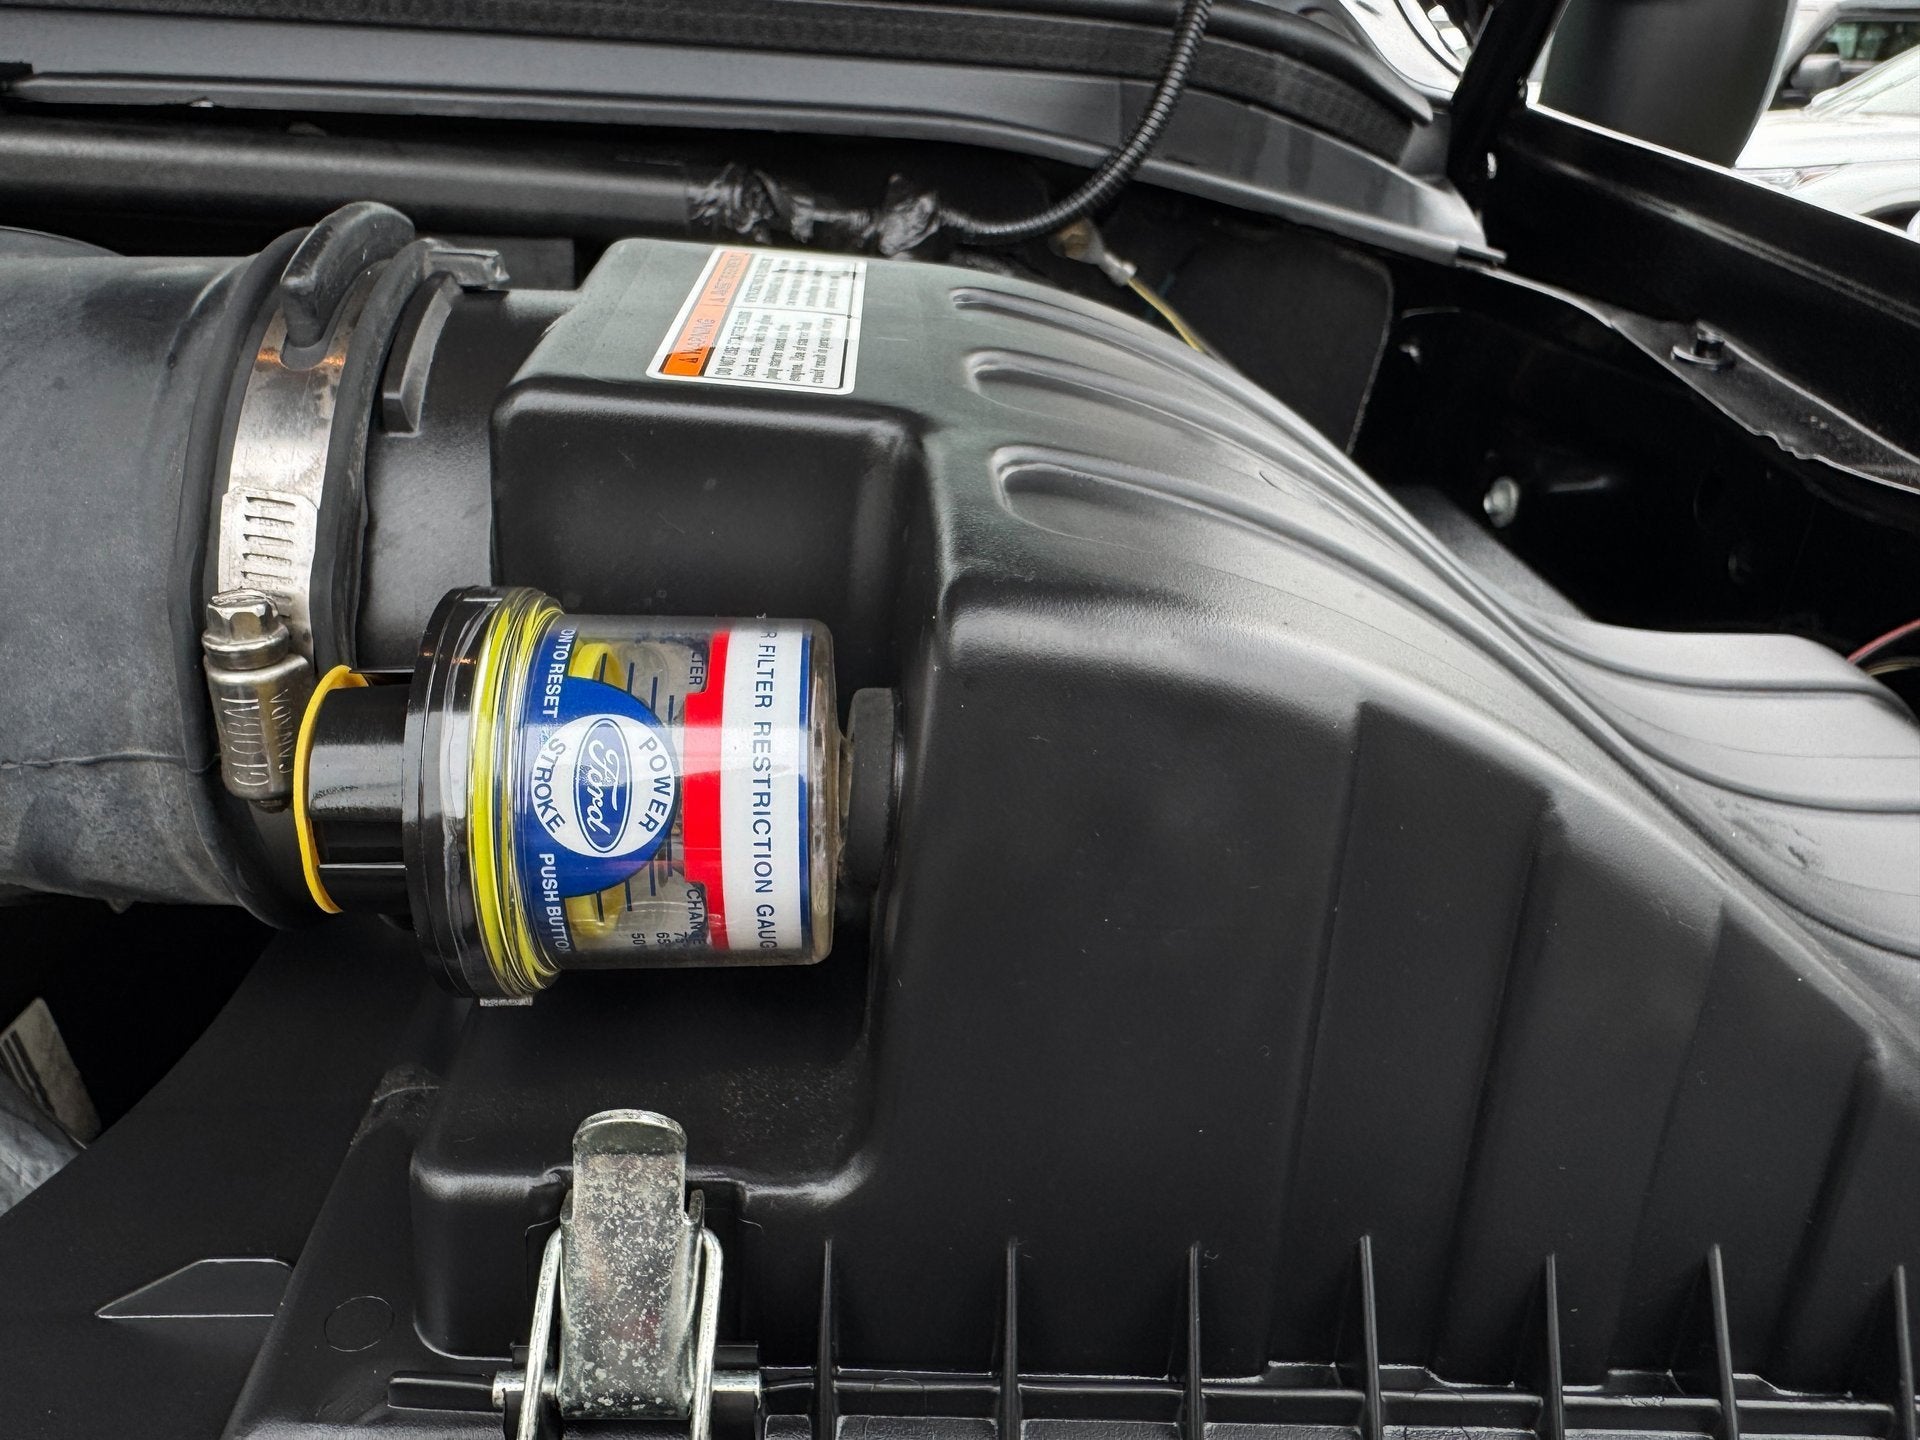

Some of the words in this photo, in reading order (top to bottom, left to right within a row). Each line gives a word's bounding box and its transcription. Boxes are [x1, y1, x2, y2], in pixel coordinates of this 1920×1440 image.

[552, 643, 572, 660] TO
[755, 644, 776, 708] FILTER
[542, 663, 565, 718] RESET
[532, 737, 567, 833] STROKE
[583, 739, 618, 834] Ford
[637, 736, 672, 832] POWER
[752, 721, 773, 893] RESTRICTION
[539, 853, 560, 902] PUSH
[756, 904, 778, 949] GAUG
